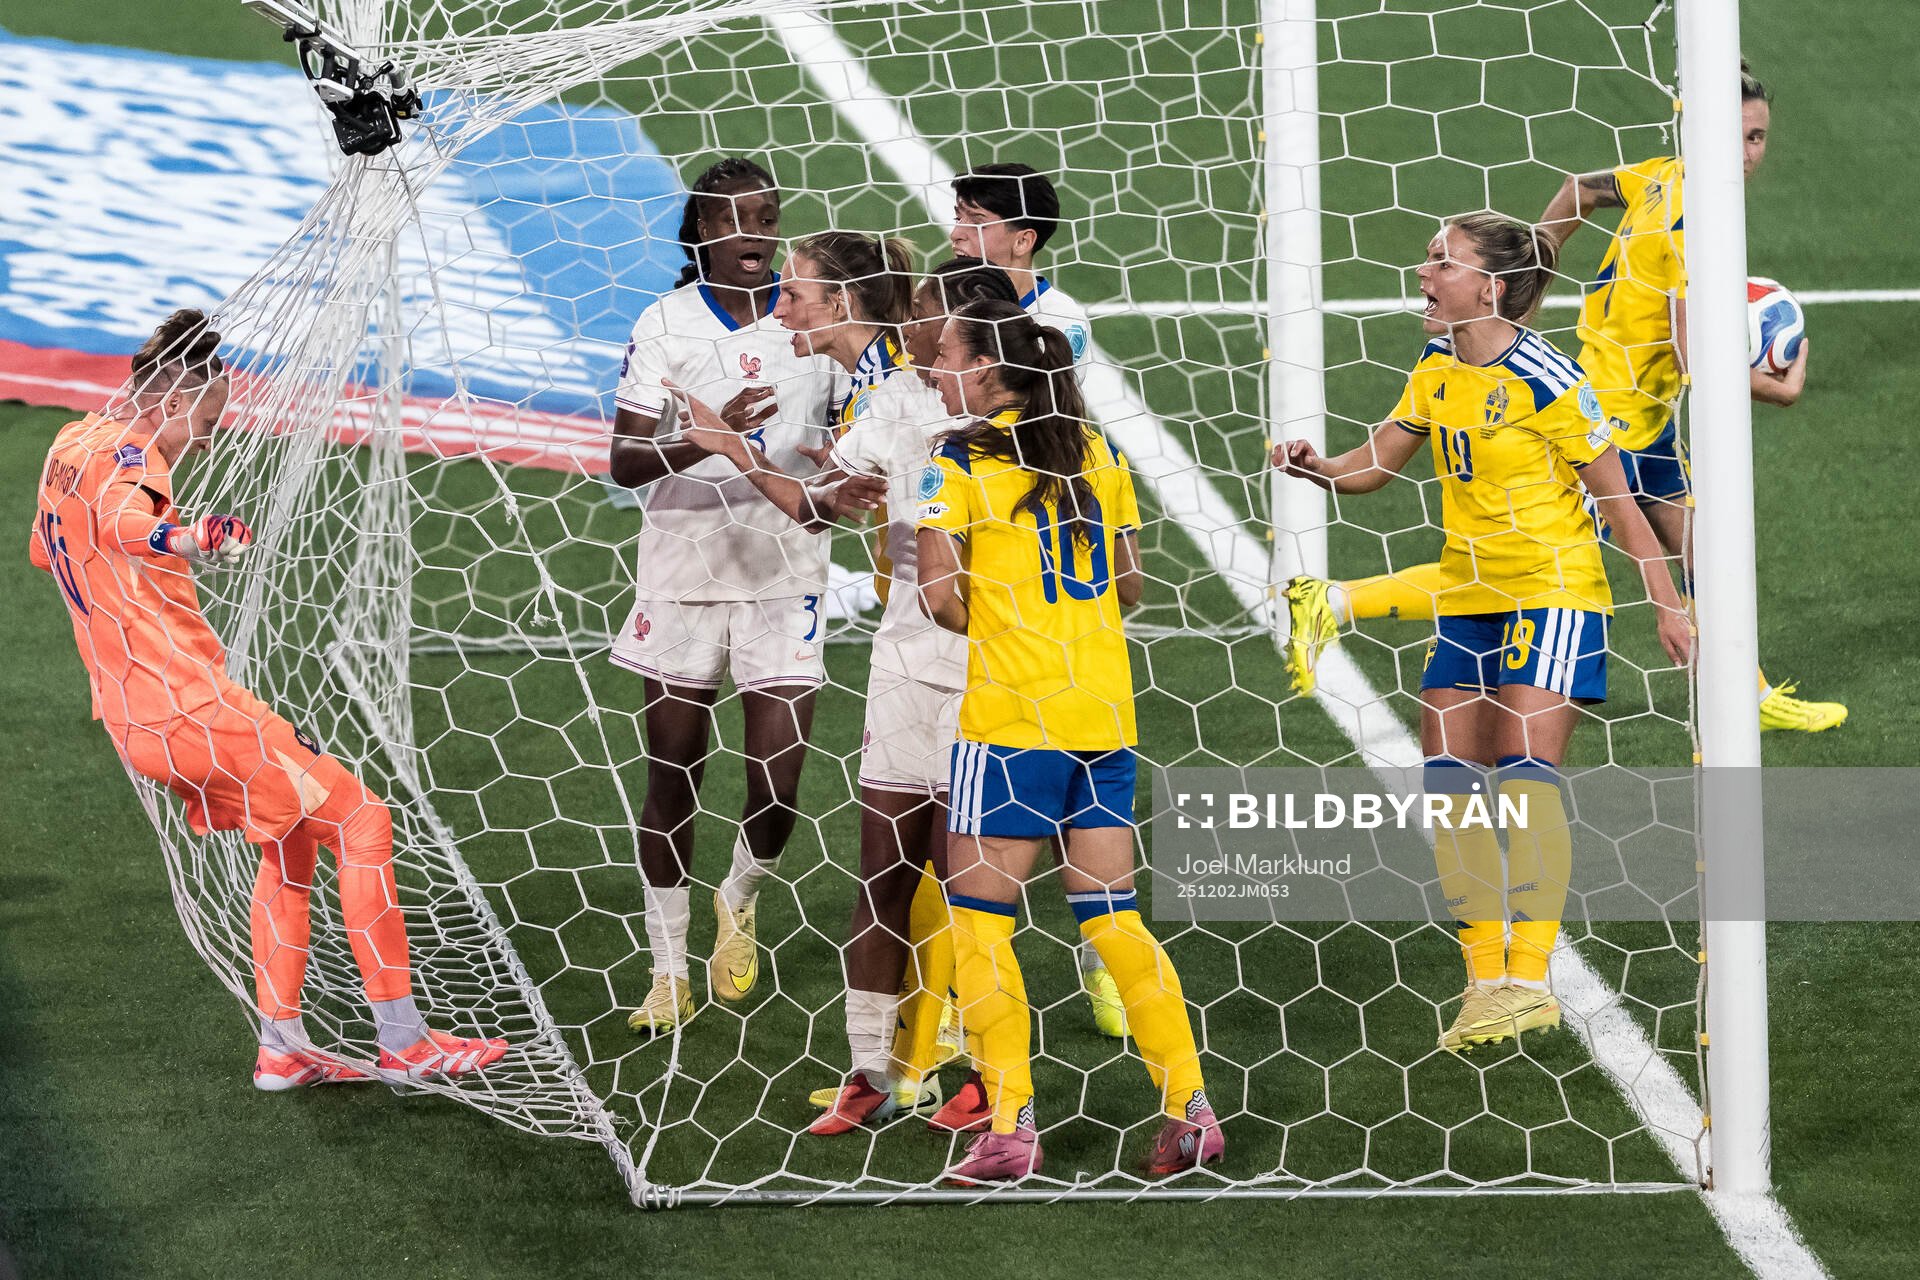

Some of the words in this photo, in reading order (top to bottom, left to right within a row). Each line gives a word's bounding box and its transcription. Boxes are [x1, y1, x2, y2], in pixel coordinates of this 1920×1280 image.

[1439, 427, 1474, 483] 19
[1026, 492, 1110, 604] 10
[803, 595, 818, 641] 3
[1500, 619, 1536, 672] 19
